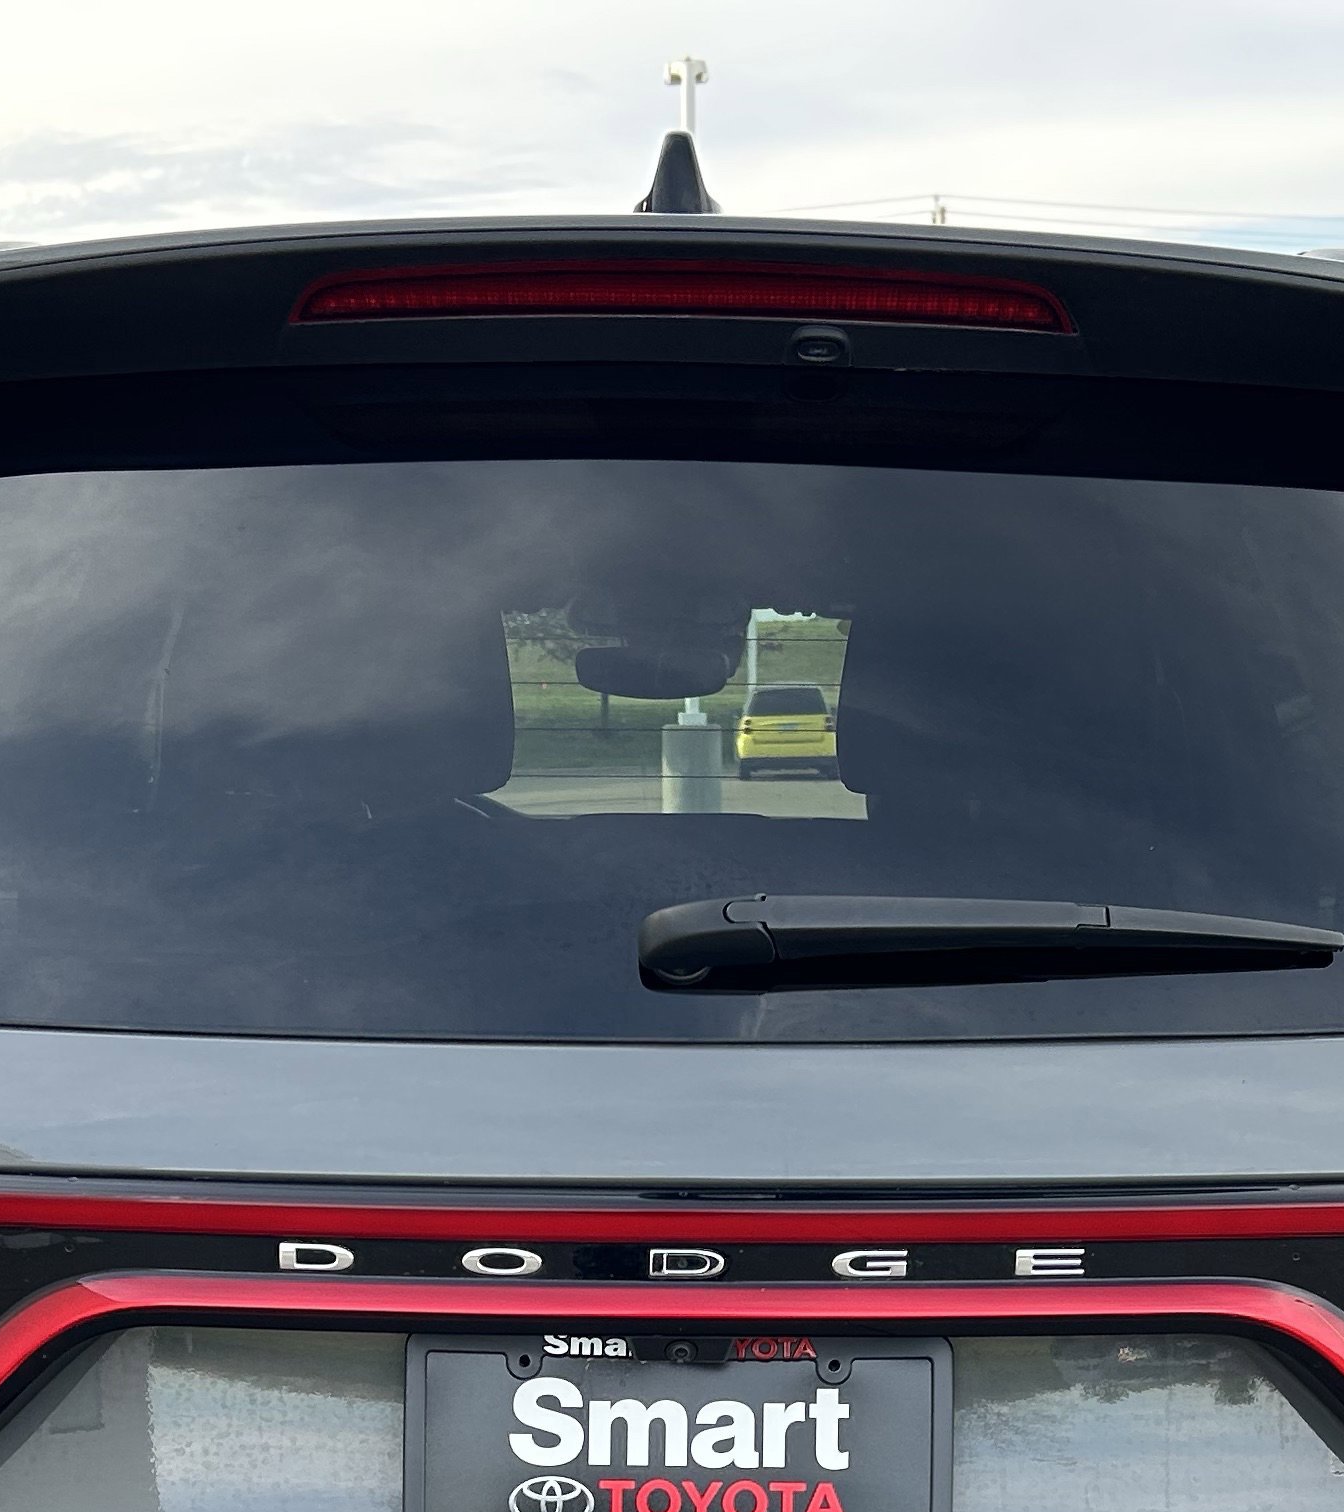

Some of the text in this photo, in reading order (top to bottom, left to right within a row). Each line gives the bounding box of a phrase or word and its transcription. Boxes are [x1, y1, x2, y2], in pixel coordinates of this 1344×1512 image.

[278, 1241, 1087, 1278] DODGE
[543, 1334, 818, 1360] Sma YOTA
[508, 1376, 851, 1470] Smart
